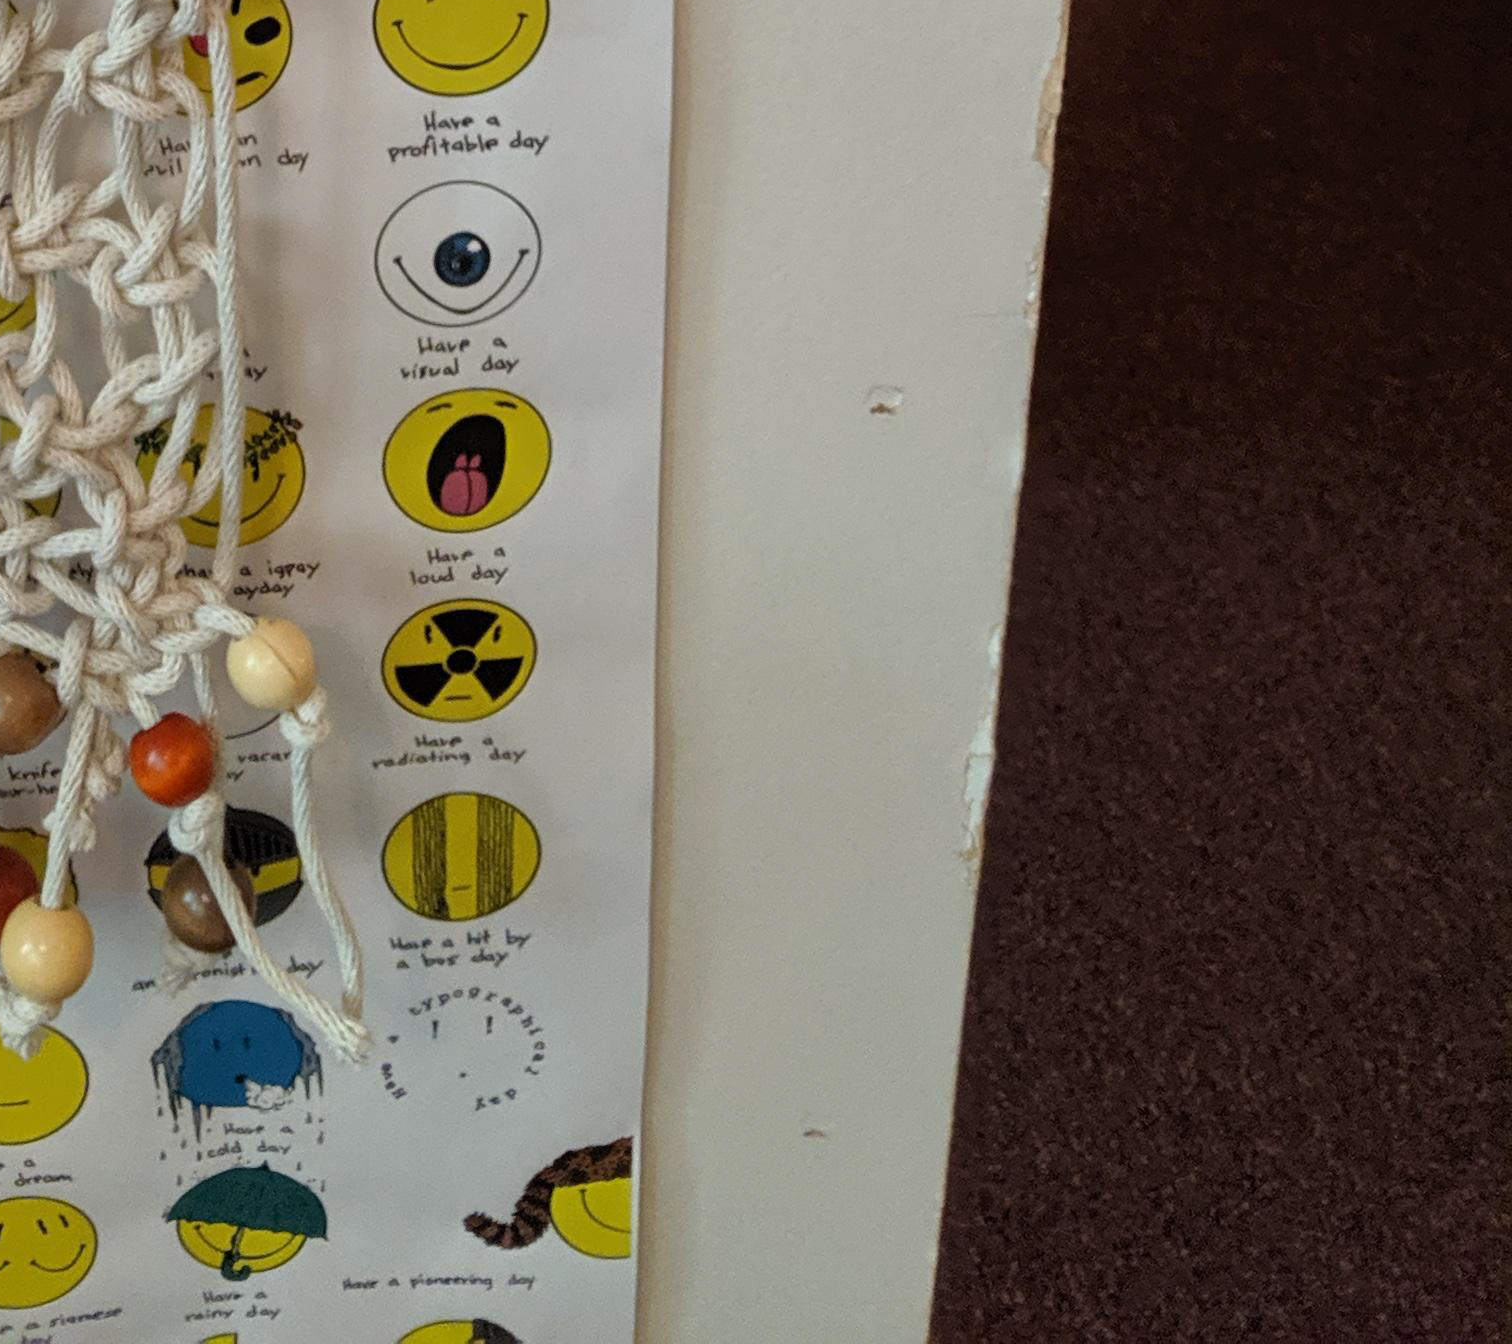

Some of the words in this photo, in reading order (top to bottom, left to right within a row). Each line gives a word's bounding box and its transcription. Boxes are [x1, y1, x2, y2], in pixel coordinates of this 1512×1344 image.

[424, 110, 474, 131] Have
[486, 116, 500, 127] a
[387, 134, 498, 163] profitable
[509, 130, 549, 155] day
[418, 337, 470, 355] Have
[493, 337, 507, 348] a
[401, 358, 459, 379] visual
[482, 355, 519, 374] day
[427, 548, 473, 565] Have
[494, 547, 506, 557] a
[409, 567, 454, 585] loud
[471, 564, 508, 584] day
[414, 735, 462, 747] Have
[482, 737, 493, 746] a
[371, 751, 471, 770] radiating
[489, 747, 526, 763] day
[223, 1123, 264, 1135] Have
[280, 1126, 294, 1134] a
[207, 1142, 245, 1160] cold
[257, 1140, 291, 1155] day
[24, 1159, 36, 1168] a
[14, 1173, 73, 1187] dream
